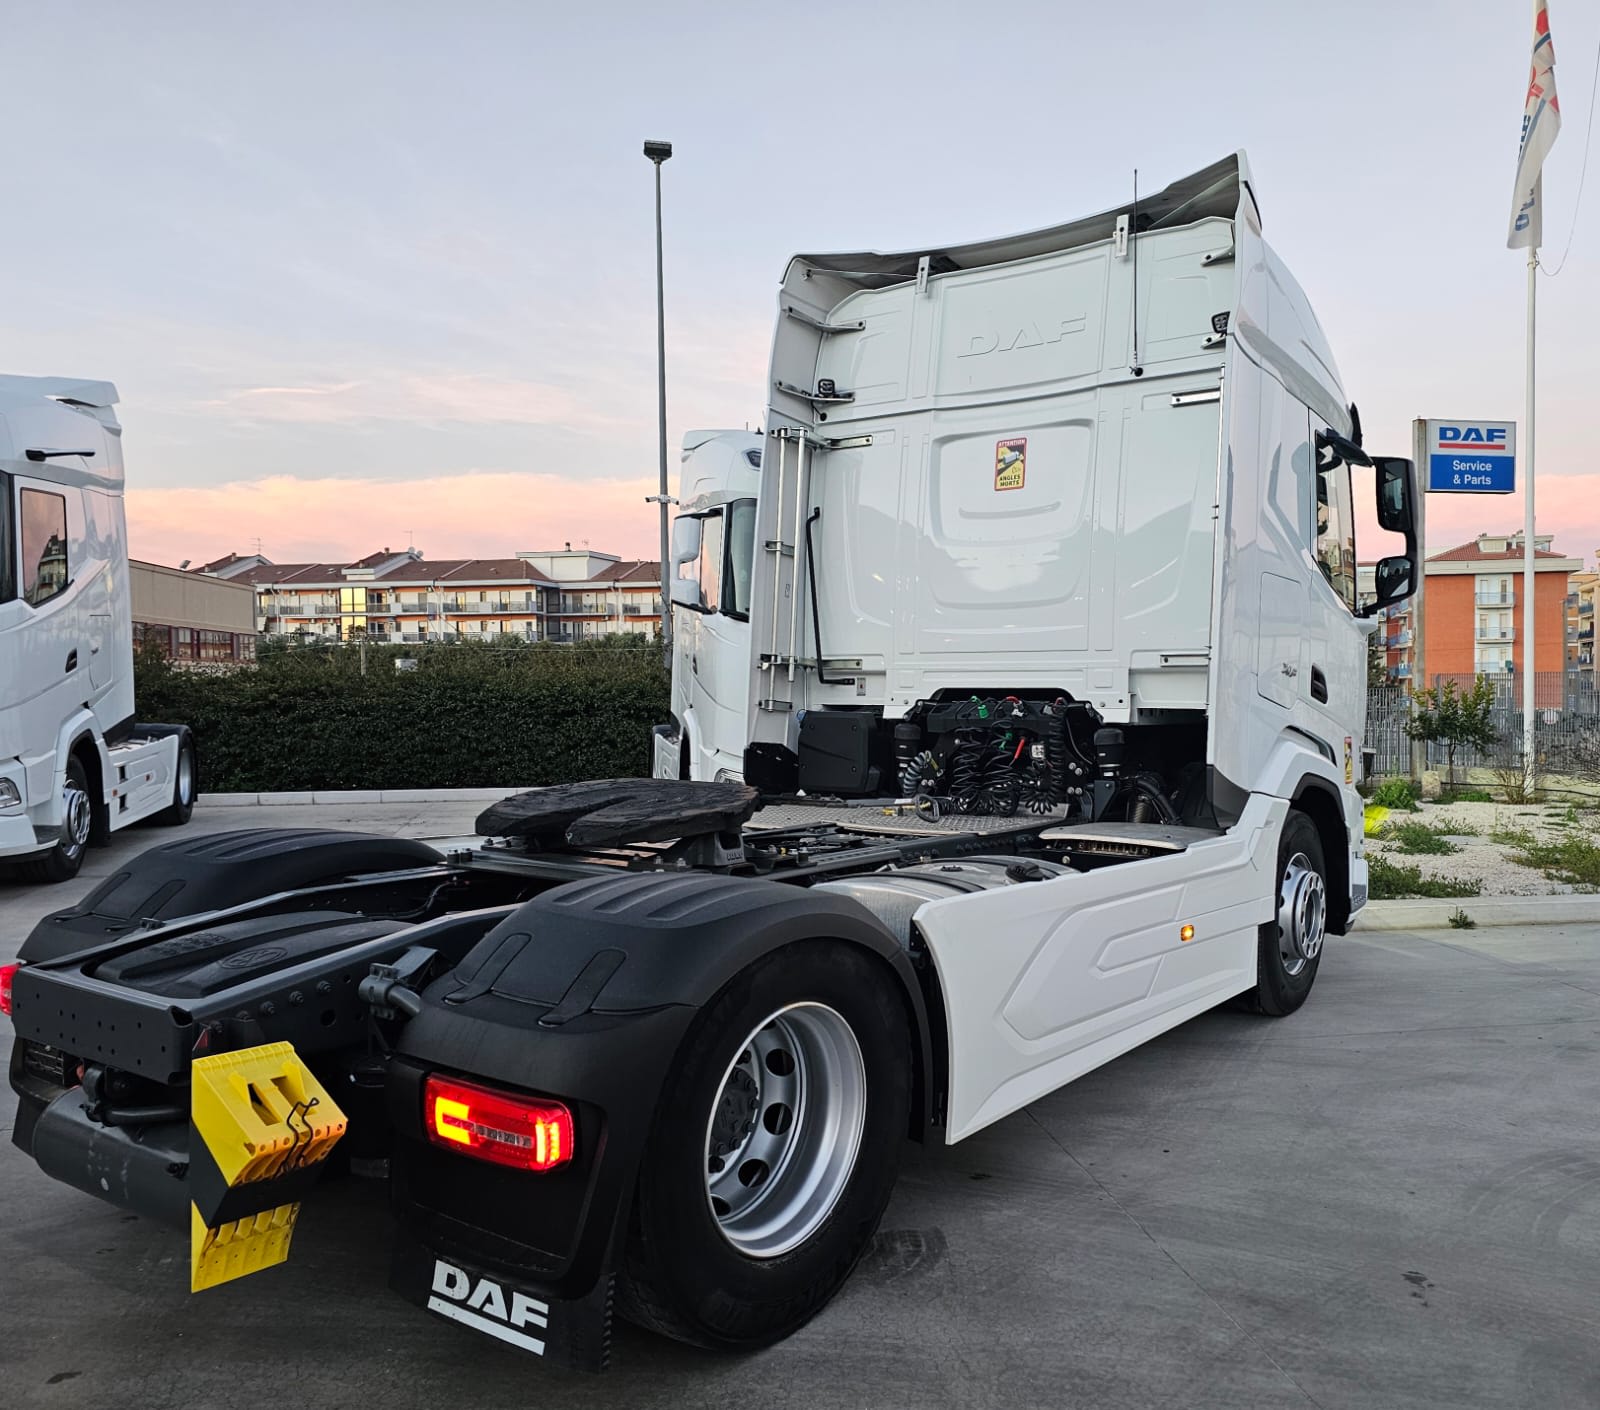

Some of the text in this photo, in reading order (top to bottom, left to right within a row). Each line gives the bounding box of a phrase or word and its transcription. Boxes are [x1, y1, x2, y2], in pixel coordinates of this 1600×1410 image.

[957, 311, 1087, 358] DAF
[1439, 427, 1506, 442] DAF
[1453, 460, 1492, 471] Service
[1453, 474, 1492, 485] & Parts
[432, 1259, 549, 1328] DAF
